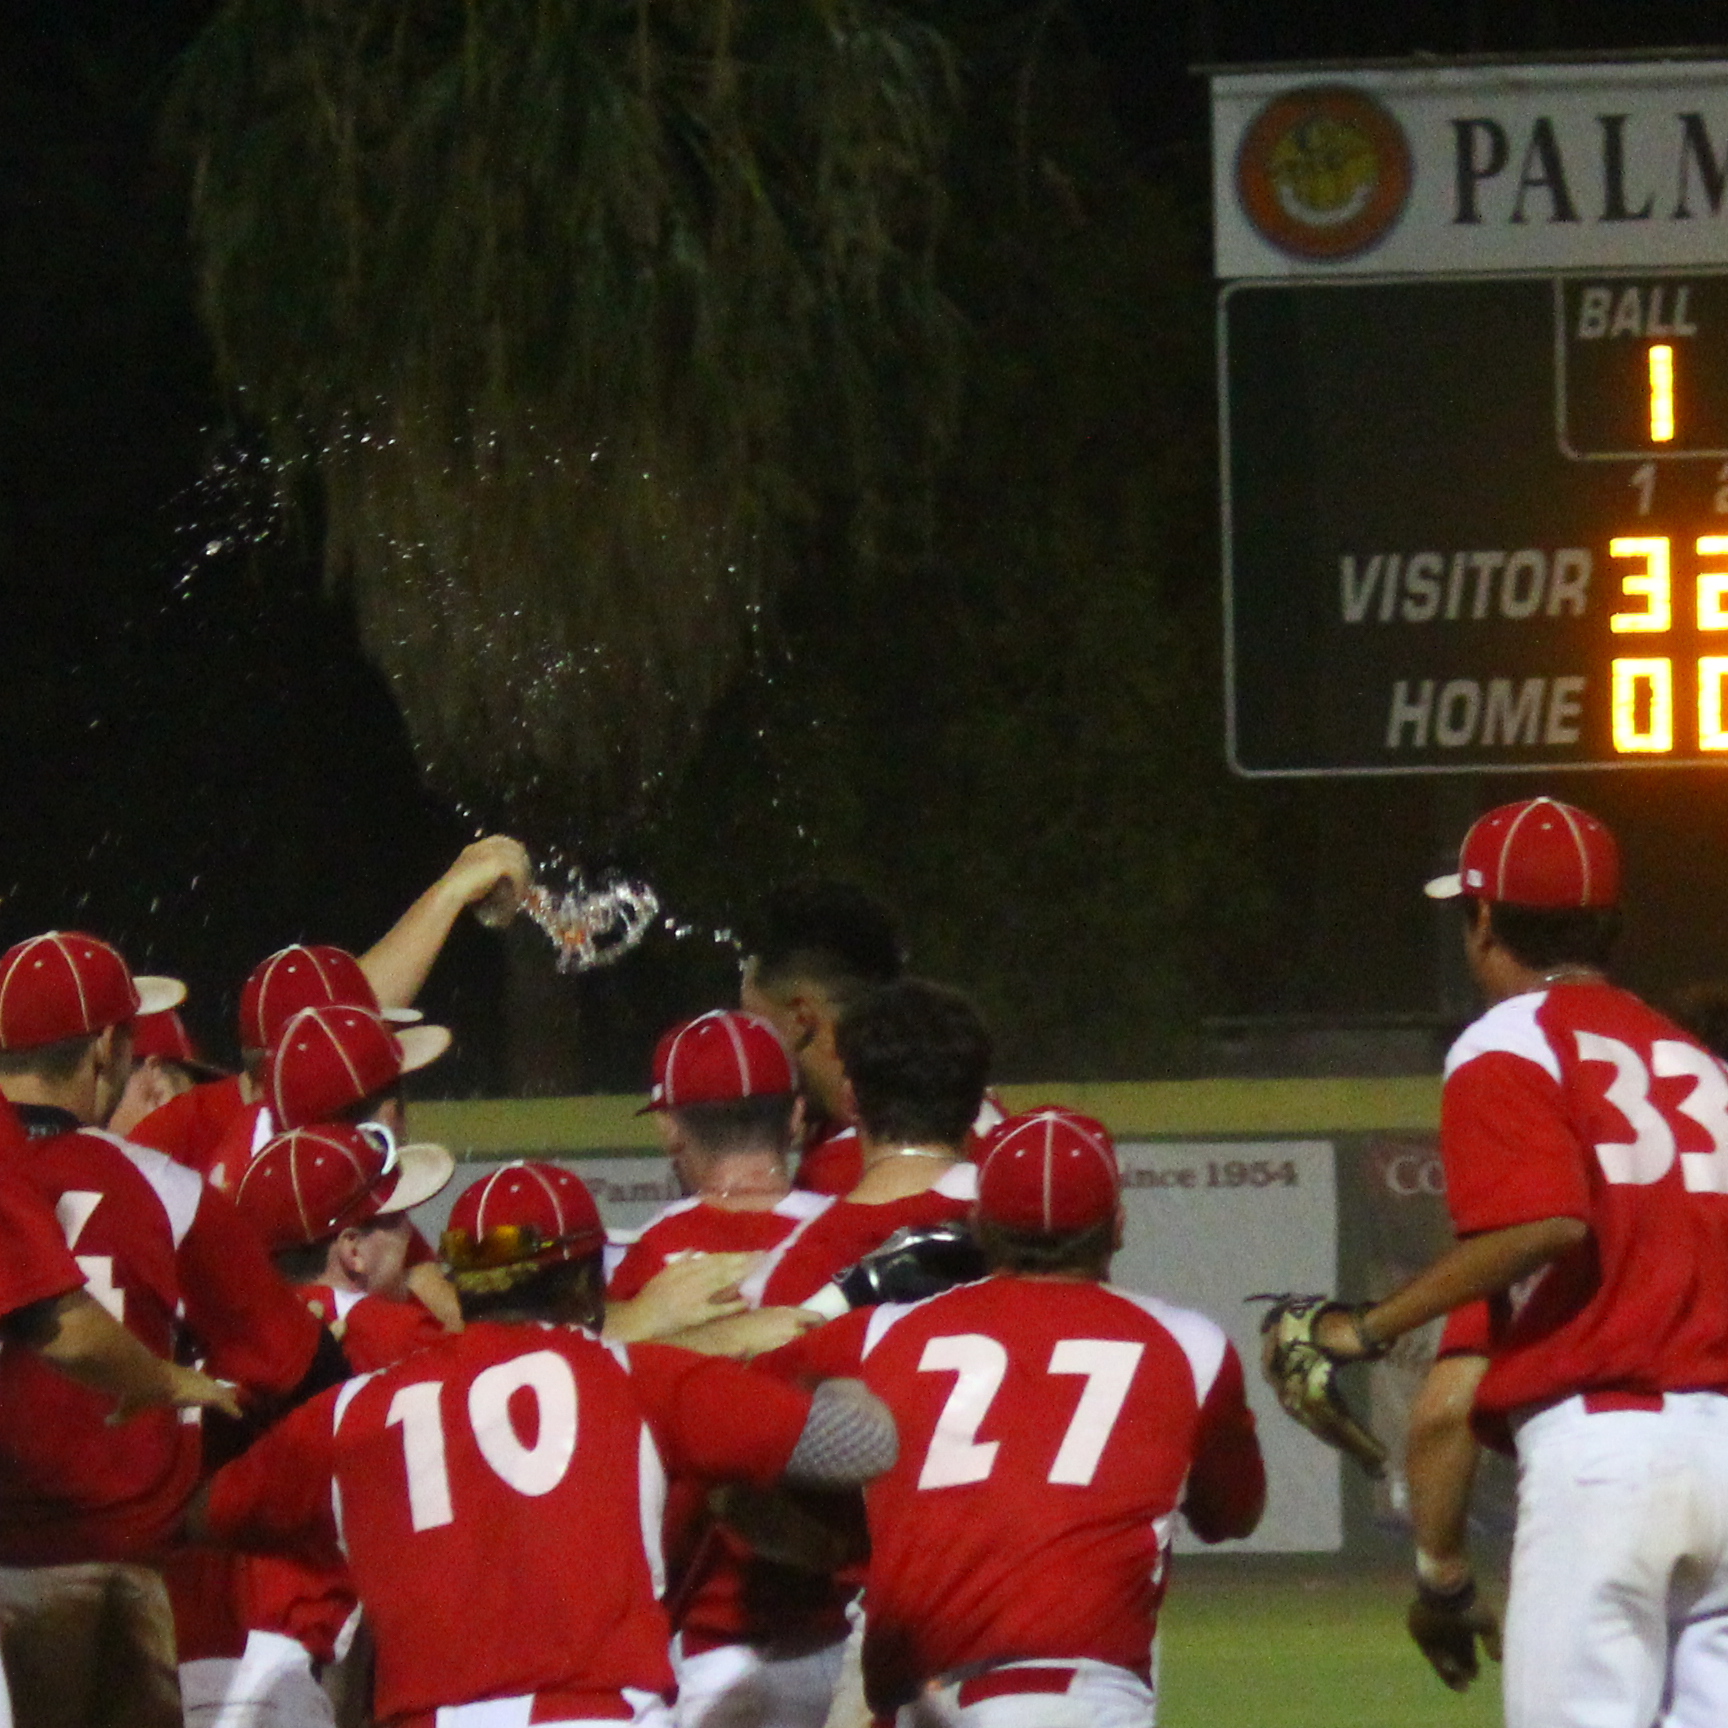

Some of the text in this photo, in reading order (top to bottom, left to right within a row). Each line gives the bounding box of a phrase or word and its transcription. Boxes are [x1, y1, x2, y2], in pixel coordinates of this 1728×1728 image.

[1577, 286, 1697, 338] BALL
[1648, 345, 1675, 442] 1
[1629, 463, 1655, 515] 1
[1337, 546, 1593, 624] VISITOR
[1385, 676, 1585, 748] HOME
[1207, 1160, 1299, 1188] 1954
[384, 1350, 578, 1533] 10
[917, 1333, 1145, 1490] 27
